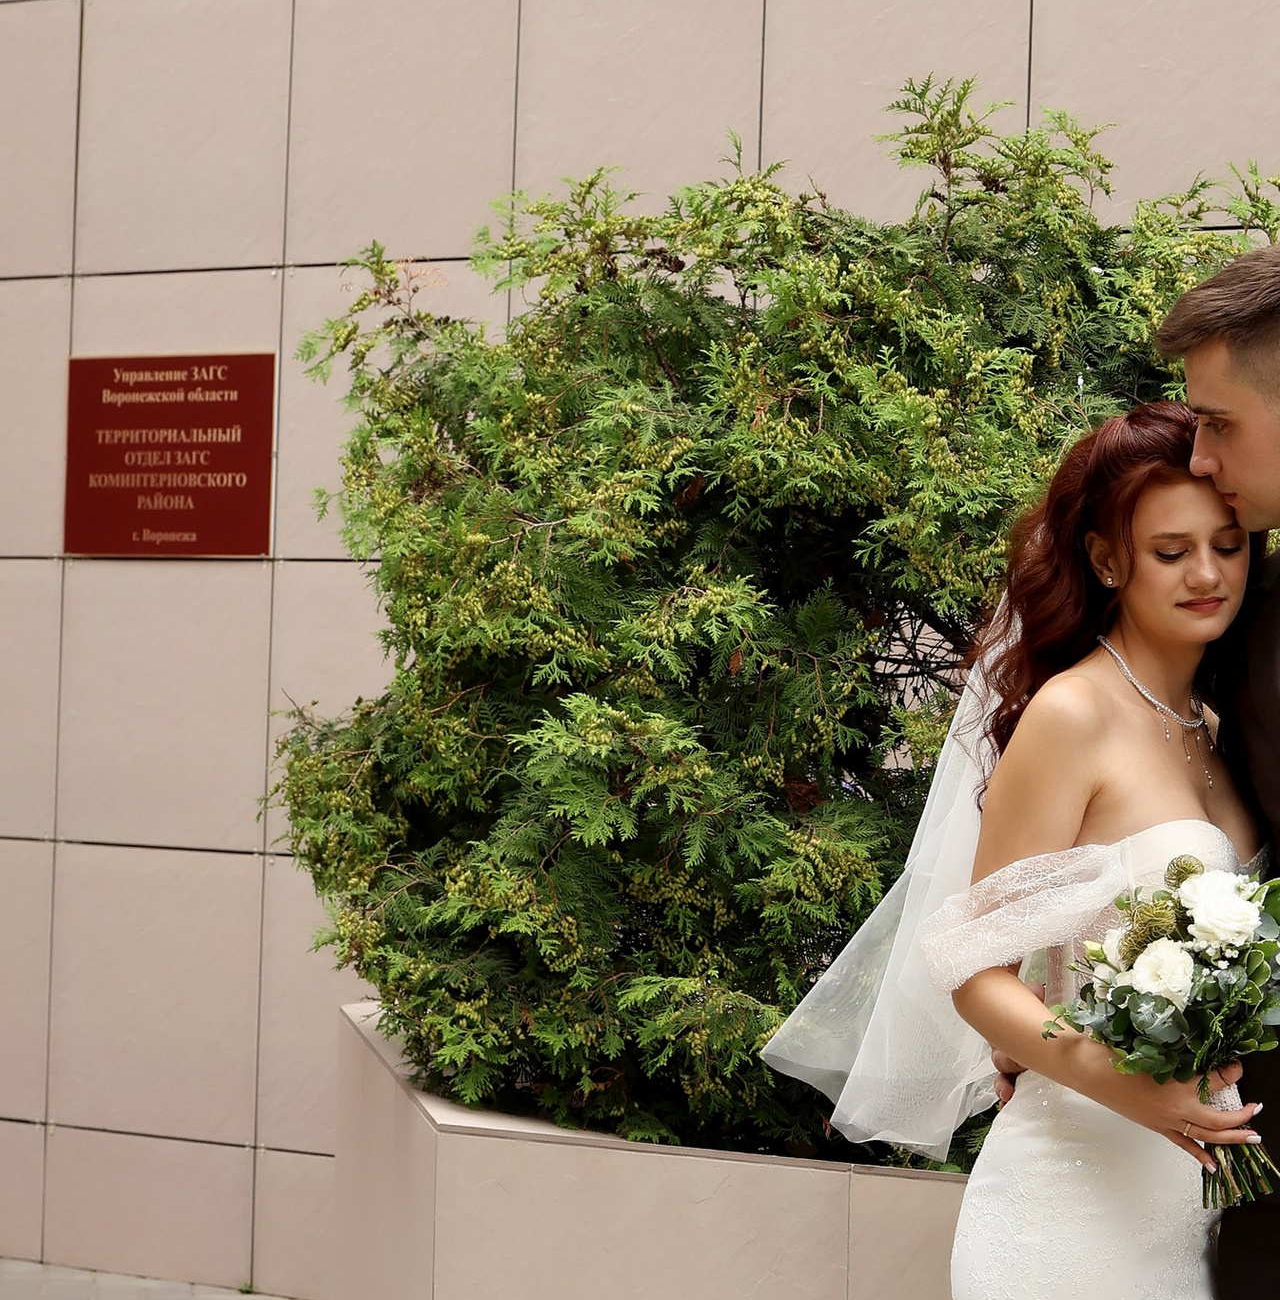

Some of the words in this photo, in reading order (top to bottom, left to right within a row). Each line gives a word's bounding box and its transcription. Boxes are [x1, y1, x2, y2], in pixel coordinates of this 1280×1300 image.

[113, 368, 187, 386] Управление
[190, 365, 228, 381] ЗАГС
[102, 388, 184, 407] Воронежской
[187, 387, 238, 402] области
[96, 424, 242, 444] ТЕРРИТОРИАЛЬНЫЙ
[124, 450, 171, 467] ОТДЕЛ
[174, 450, 211, 465] ЗАГС
[88, 472, 247, 488] КОМИНТЕРНОВСКОГО
[137, 492, 195, 510] РАЙОНА
